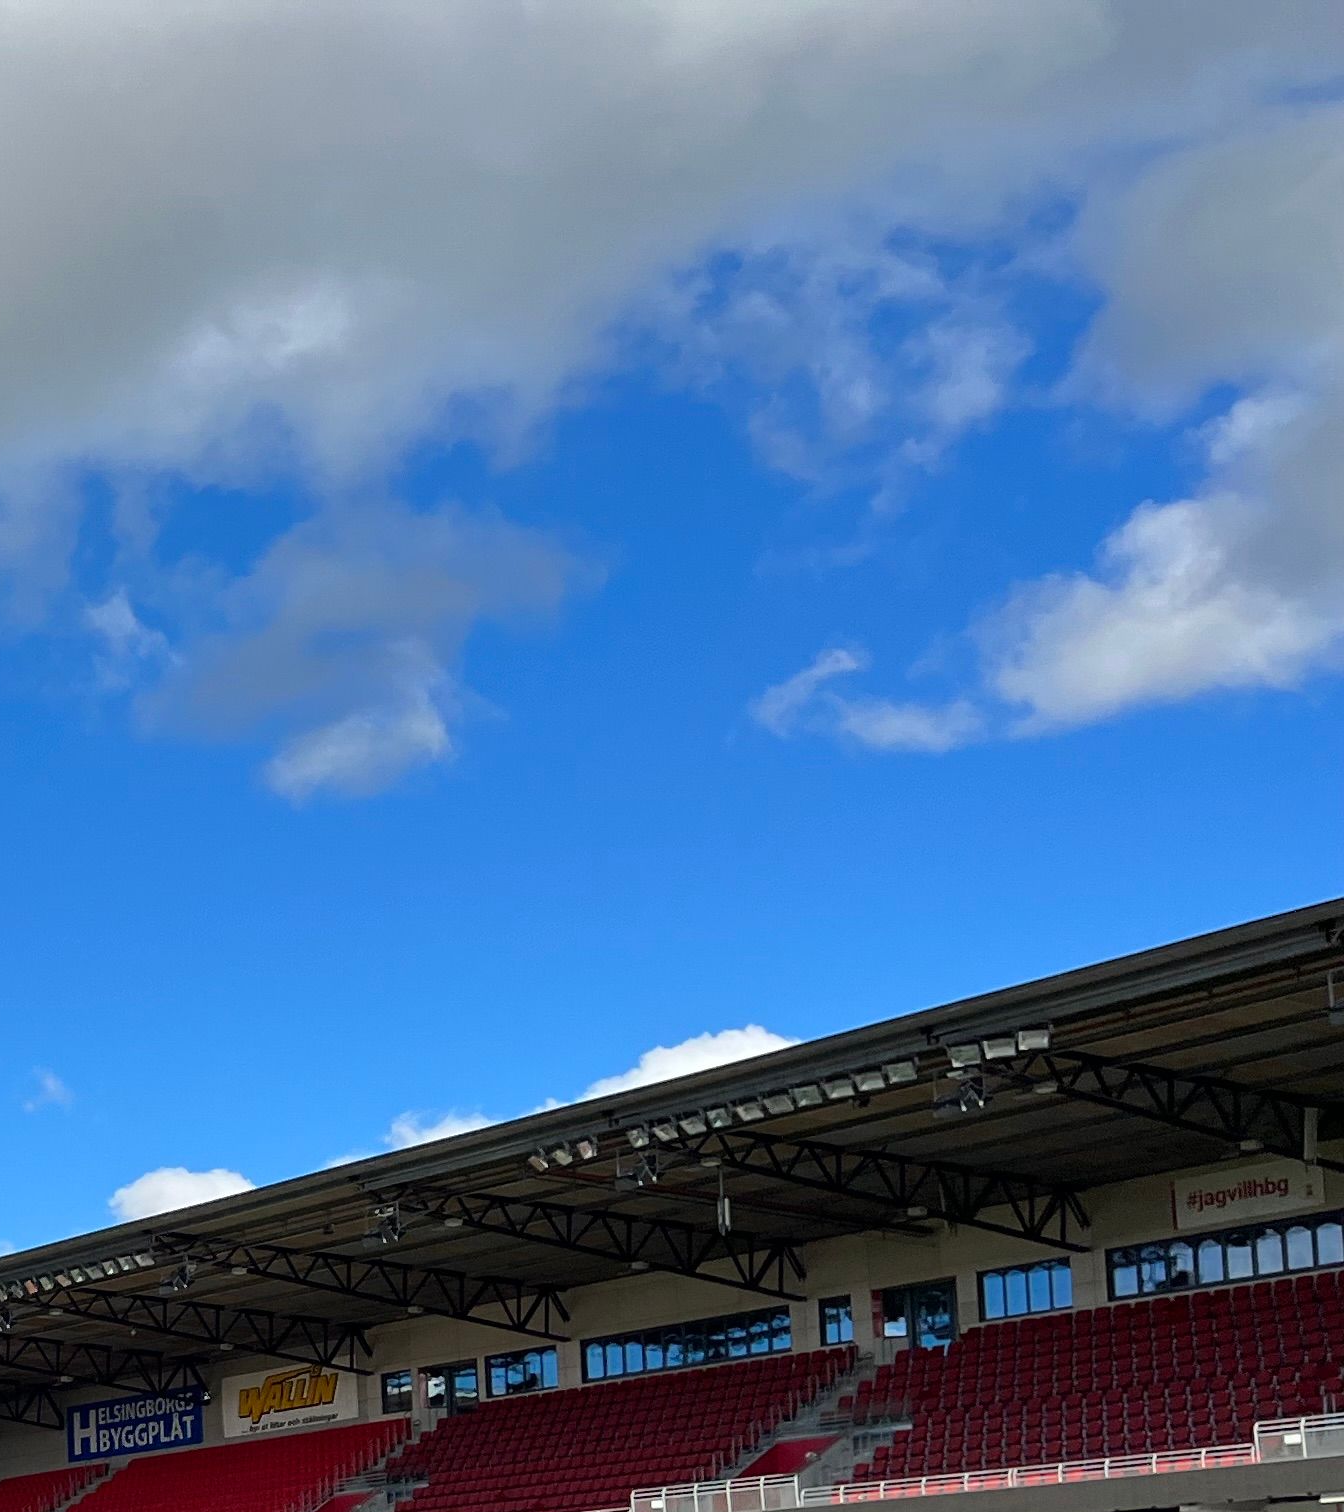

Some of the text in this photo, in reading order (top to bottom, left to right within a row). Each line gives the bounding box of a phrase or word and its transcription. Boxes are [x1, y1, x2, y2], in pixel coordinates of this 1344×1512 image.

[1186, 1177, 1289, 1212] #jagvillhbg
[238, 1372, 339, 1424] WALLIN
[99, 1412, 195, 1452] BYGGPLÅT
